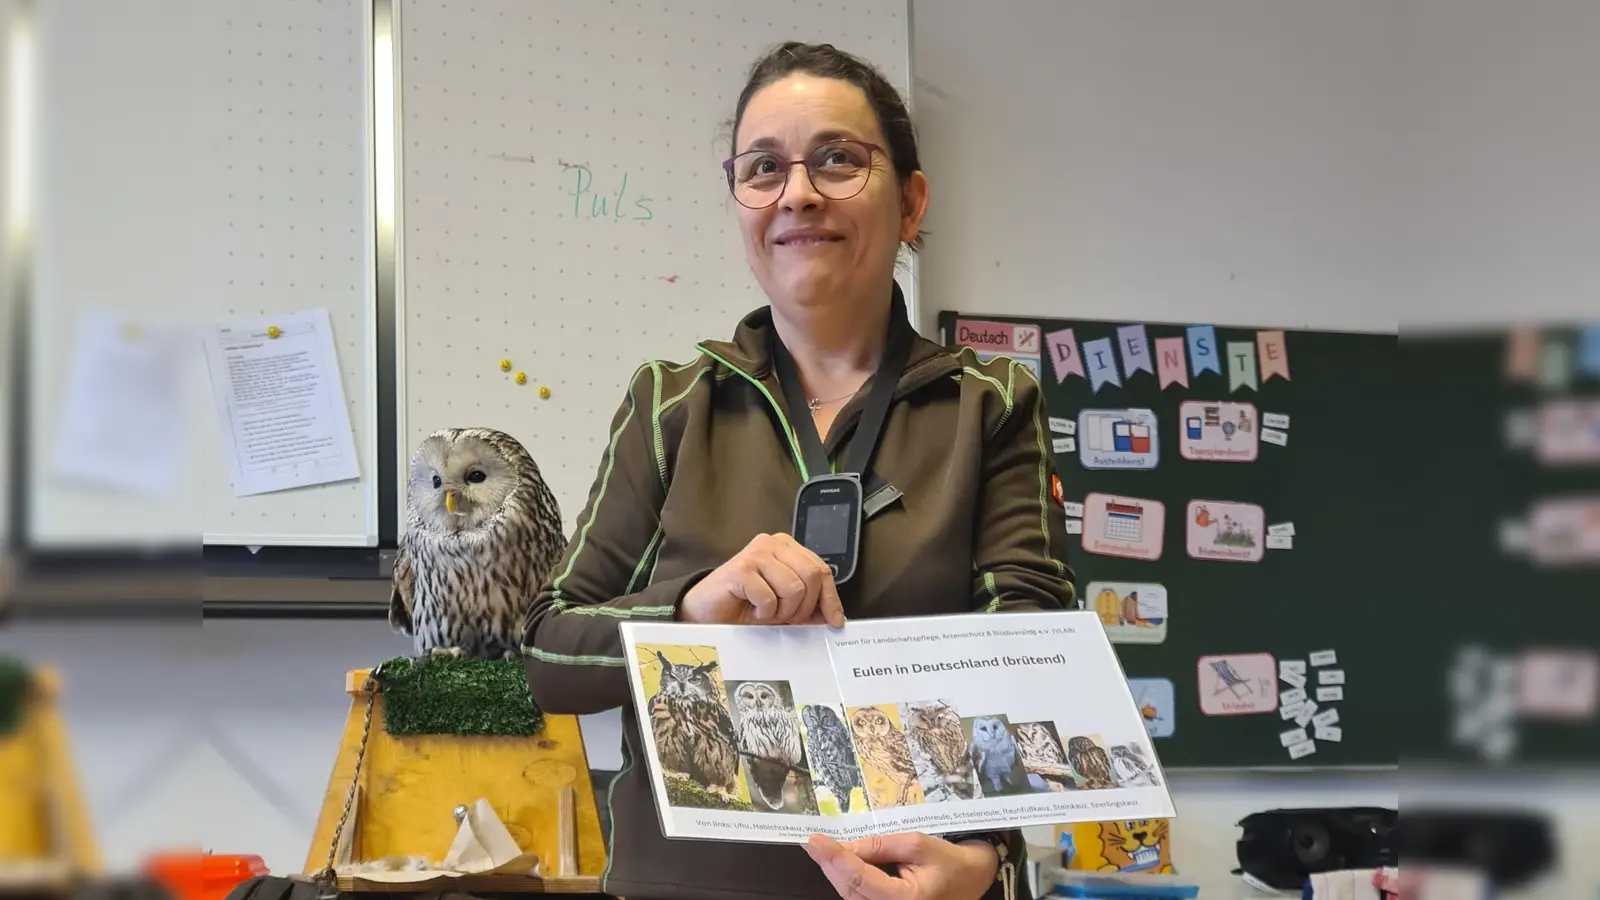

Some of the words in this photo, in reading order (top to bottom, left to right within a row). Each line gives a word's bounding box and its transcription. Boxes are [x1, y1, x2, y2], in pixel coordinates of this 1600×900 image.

[562, 164, 654, 220] Puls
[959, 326, 1008, 345] Deutsch
[1056, 337, 1280, 372] DIENSTE
[835, 638, 860, 647] Verein
[861, 637, 871, 645] für
[873, 632, 941, 644] Landschaftspflege,
[942, 631, 985, 640] Artenschutz
[853, 666, 892, 678] Eulen
[895, 664, 909, 675] in
[911, 656, 1000, 674] Deutschland
[1002, 653, 1066, 668] (brütend)
[712, 820, 732, 828] links:
[733, 821, 752, 830] Uhu,
[753, 823, 805, 832] Habichtskauz,
[805, 826, 842, 835] Waldkauz,
[843, 820, 901, 835] Sumpfohreule,
[901, 814, 952, 825] Waldohreule,
[953, 809, 1002, 819] Schleiereule,
[1053, 802, 1090, 811] Steinkauz,
